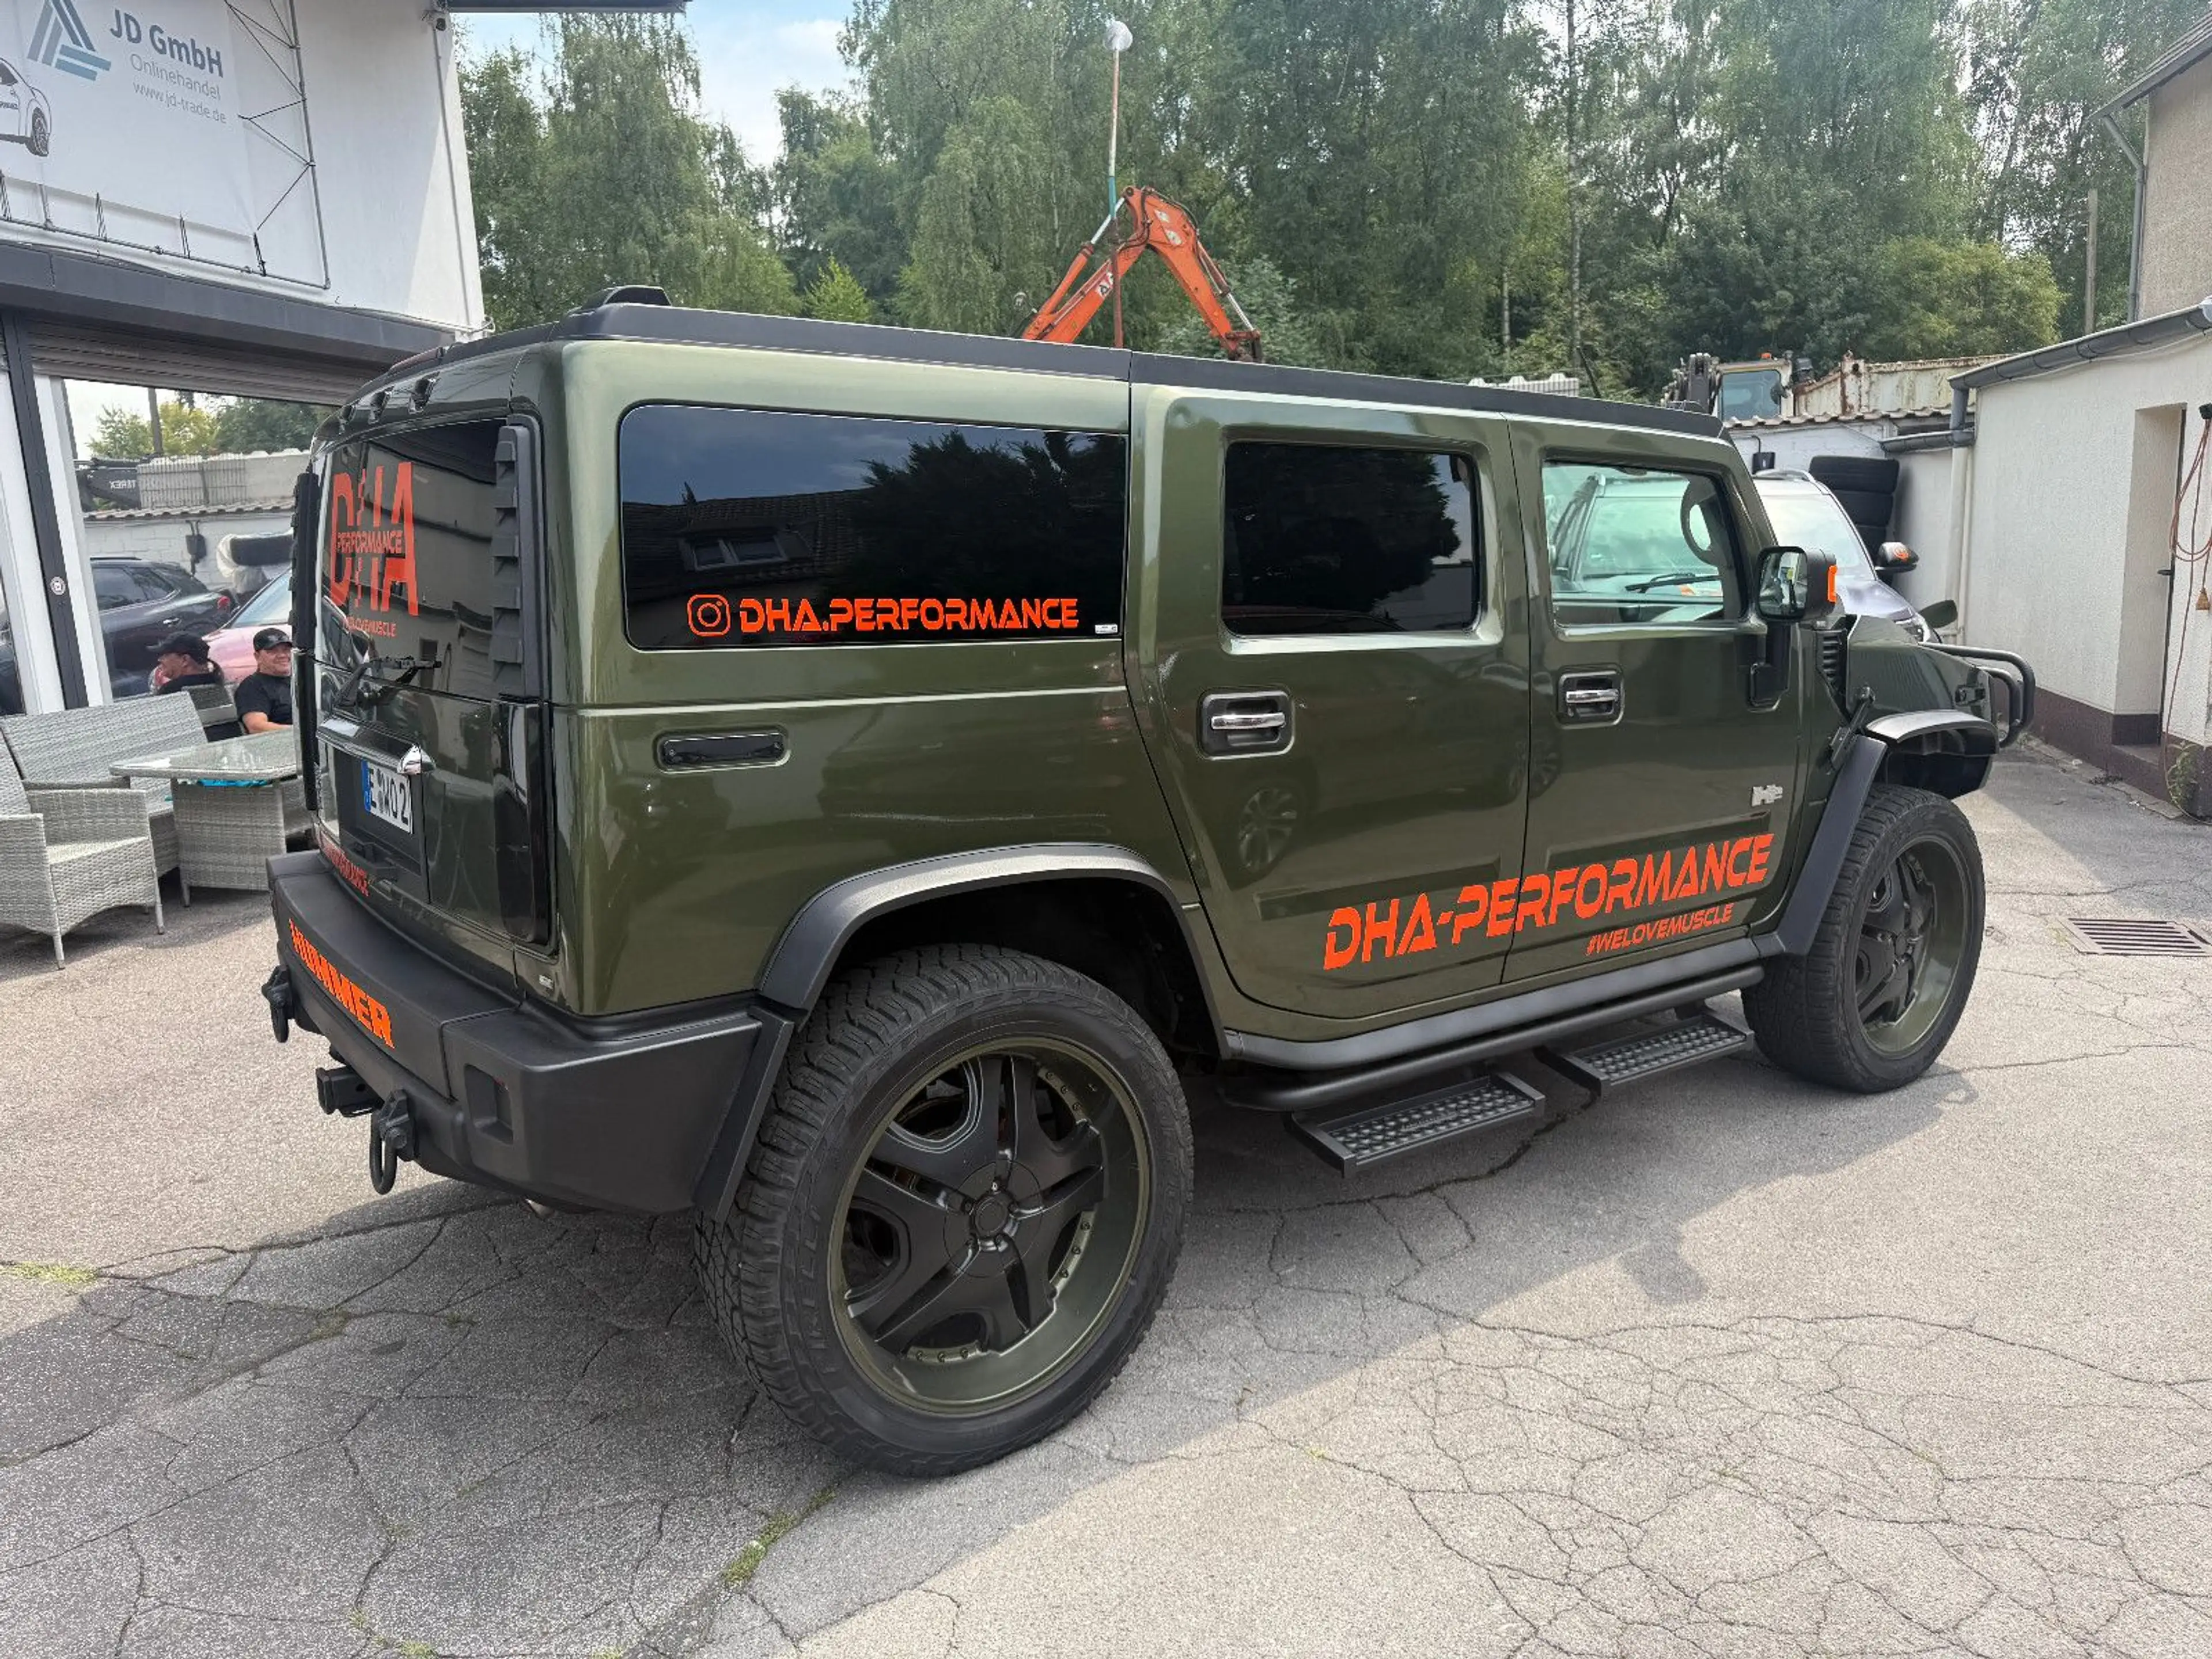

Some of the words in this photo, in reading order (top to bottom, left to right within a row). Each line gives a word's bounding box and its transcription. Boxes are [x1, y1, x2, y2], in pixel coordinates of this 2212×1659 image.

[110, 9, 142, 44] JD
[149, 24, 224, 78] GmbH
[130, 53, 221, 101] Onlinehandel
[132, 82, 227, 124] www.jd-trade.de
[337, 531, 402, 554] PERFORMANCE
[739, 597, 1080, 633] DHA.PERFORMANCE
[1323, 834, 1775, 971] DHA-PERFORMANCE
[1585, 902, 1734, 956] #WELOVEMUSCLE
